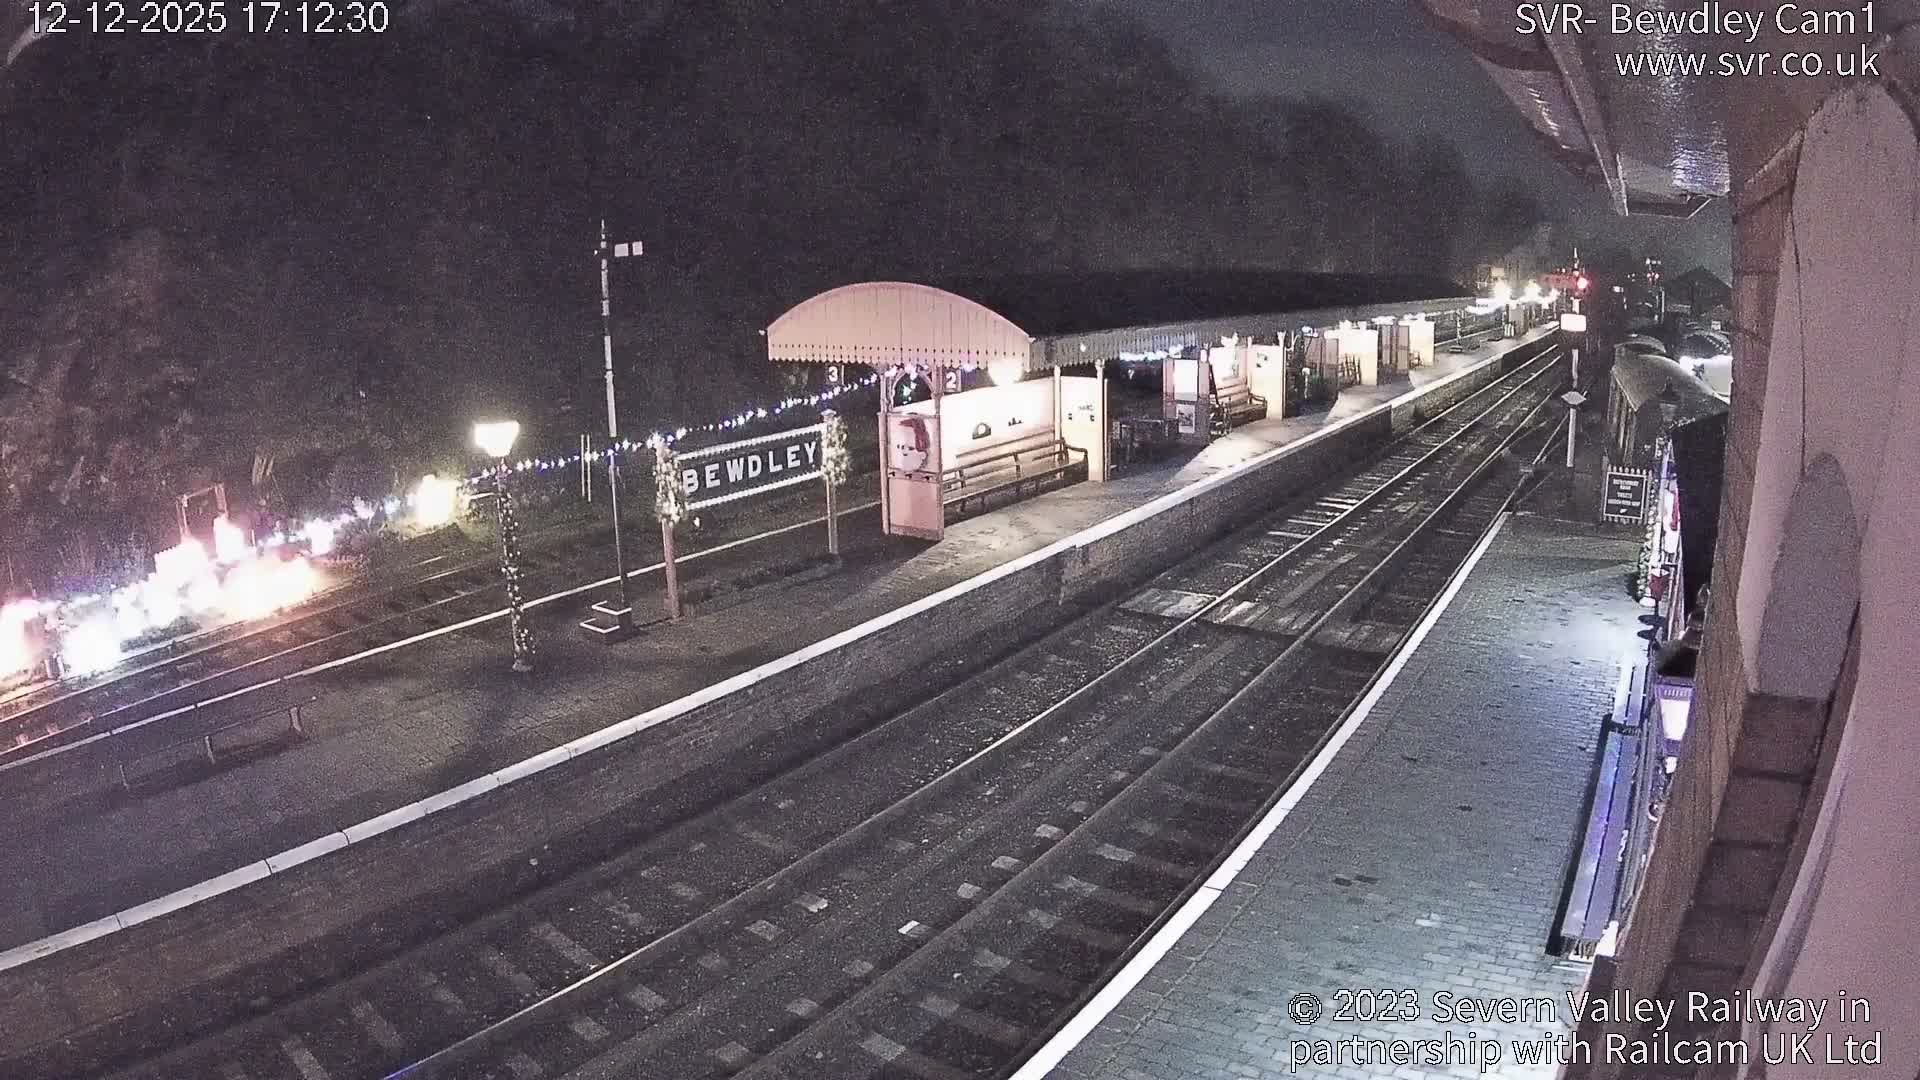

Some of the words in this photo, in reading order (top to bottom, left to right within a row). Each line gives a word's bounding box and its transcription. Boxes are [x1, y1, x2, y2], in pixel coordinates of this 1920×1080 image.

[827, 366, 840, 383] 3
[945, 371, 958, 389] 2
[682, 440, 817, 496] BEWDLEY
